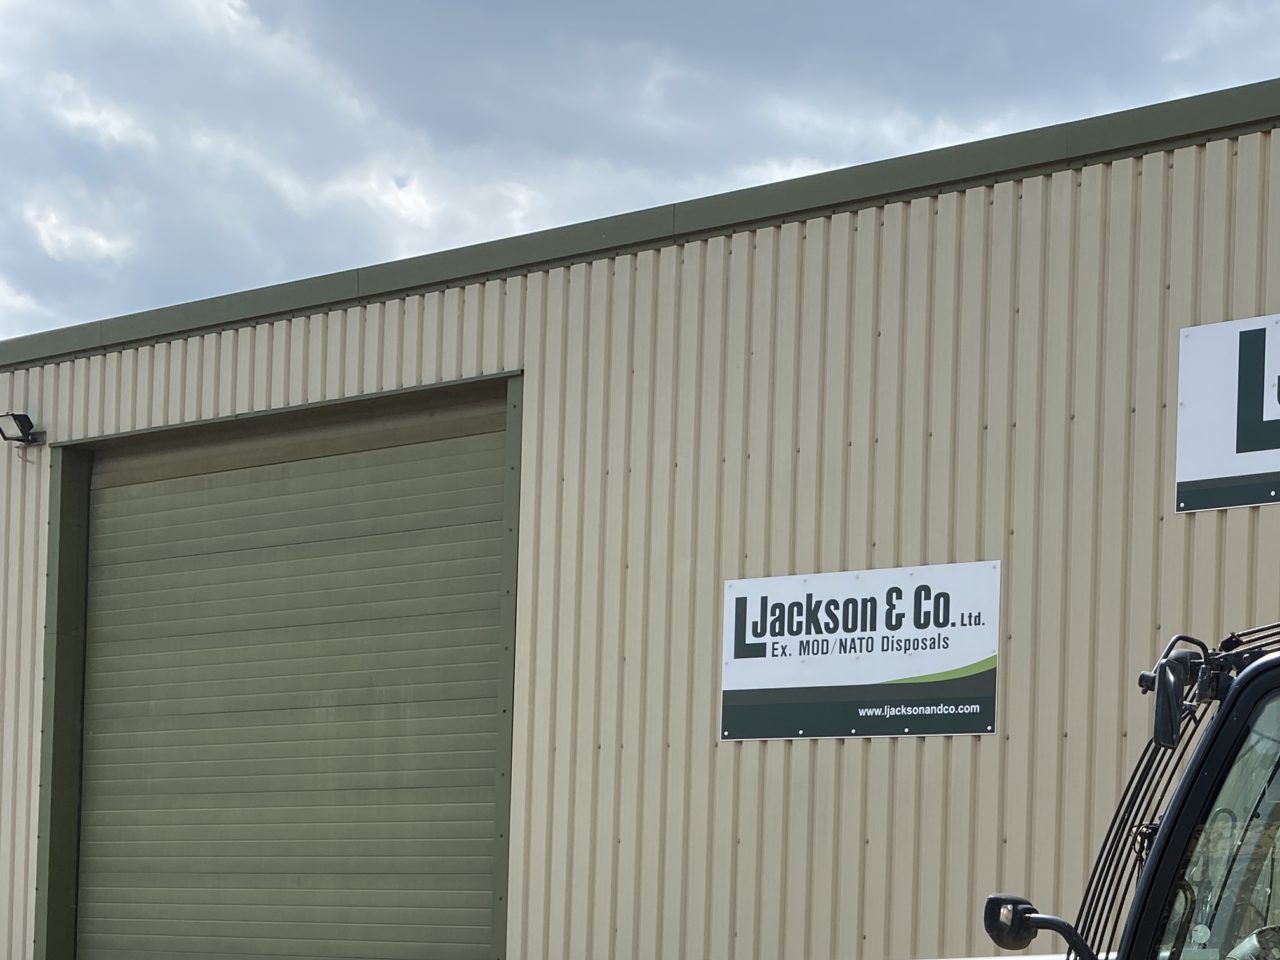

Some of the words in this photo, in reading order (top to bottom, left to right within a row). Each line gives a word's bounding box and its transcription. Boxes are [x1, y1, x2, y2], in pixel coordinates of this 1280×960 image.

[885, 587, 905, 631] &
[914, 585, 956, 630] Co.
[961, 612, 985, 627] Ltd.
[771, 641, 792, 657] Ex.
[799, 637, 874, 656] MOD/NATO
[881, 633, 950, 655] Disposals
[858, 703, 980, 718] www.ljacksonandco.com
